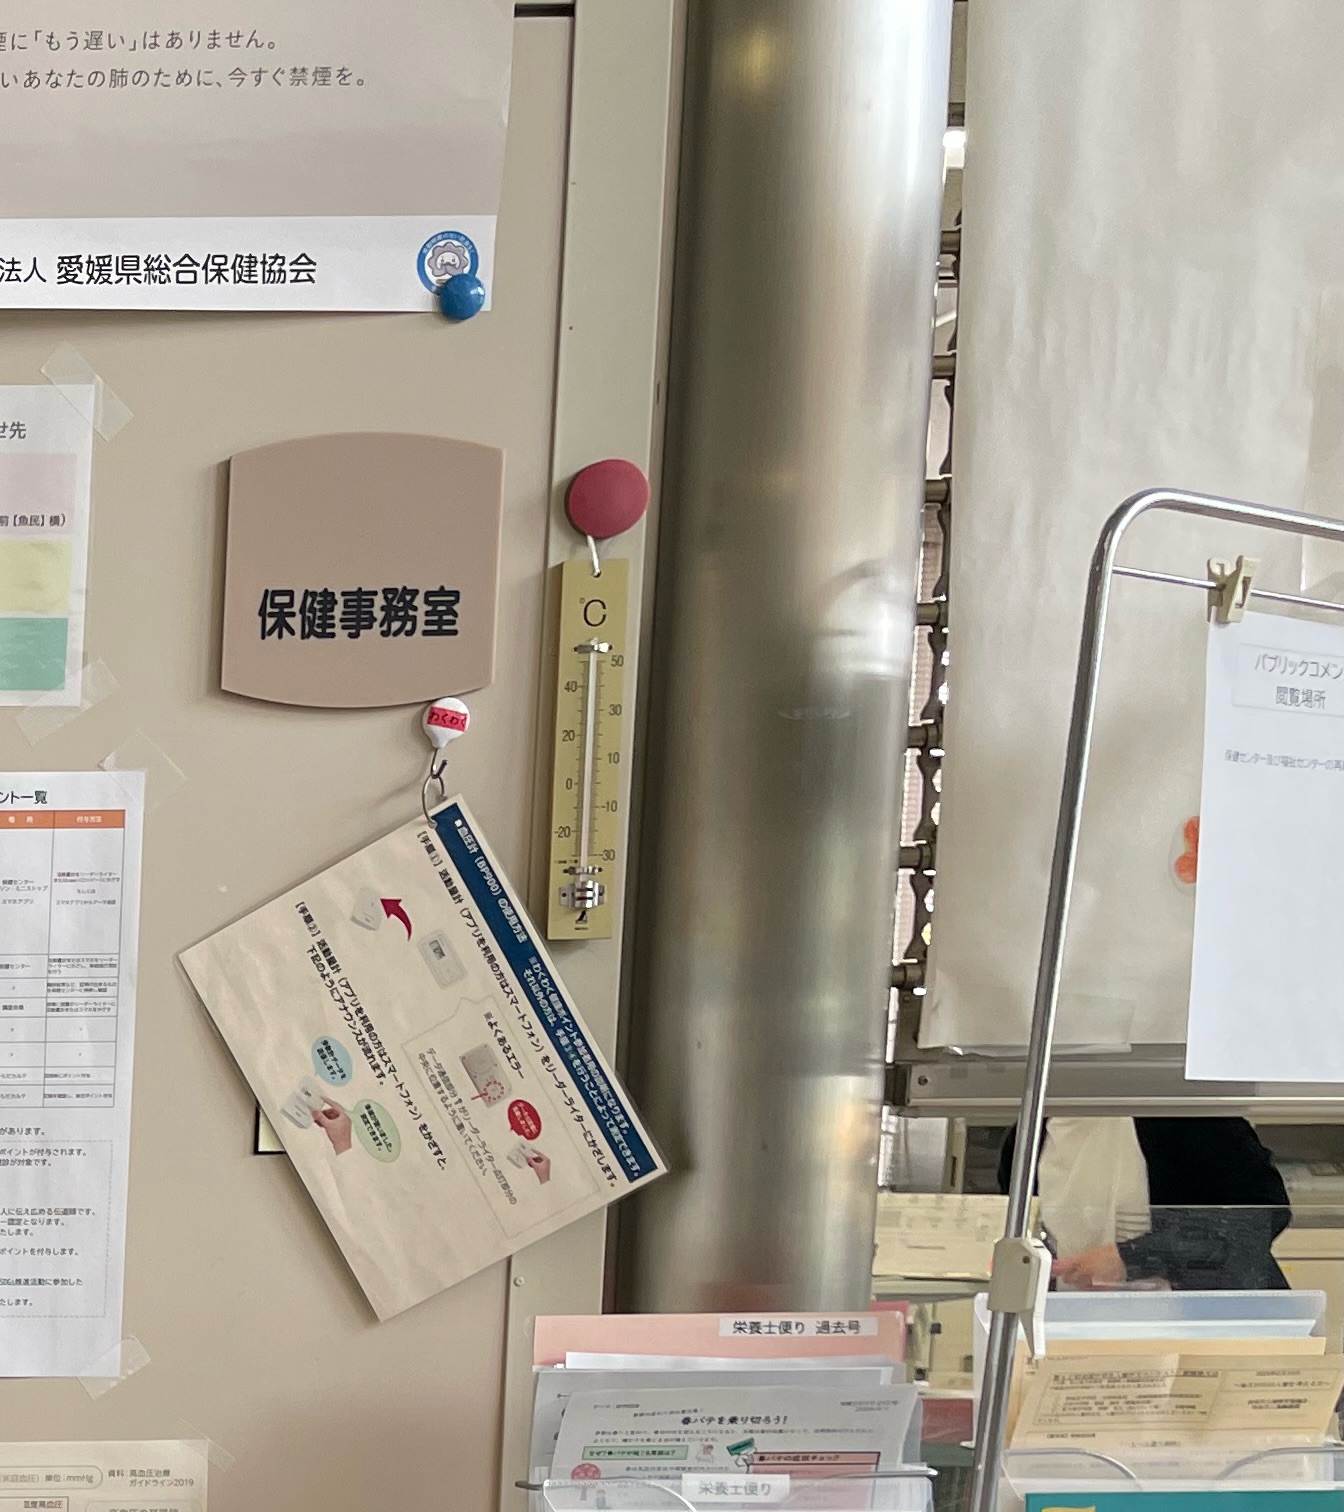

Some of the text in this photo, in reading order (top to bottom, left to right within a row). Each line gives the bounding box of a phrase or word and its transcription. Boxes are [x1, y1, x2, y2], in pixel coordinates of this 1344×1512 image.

[57, 254, 317, 287] 愛媛県総合保健協会
[257, 585, 462, 640] 保健事務室
[610, 654, 624, 668] 50
[564, 680, 578, 693] 40
[608, 703, 622, 717] 30
[561, 728, 575, 742] 20
[733, 1321, 861, 1335] 栄養士便り 過去号
[698, 1482, 772, 1496] 栄養士便り
